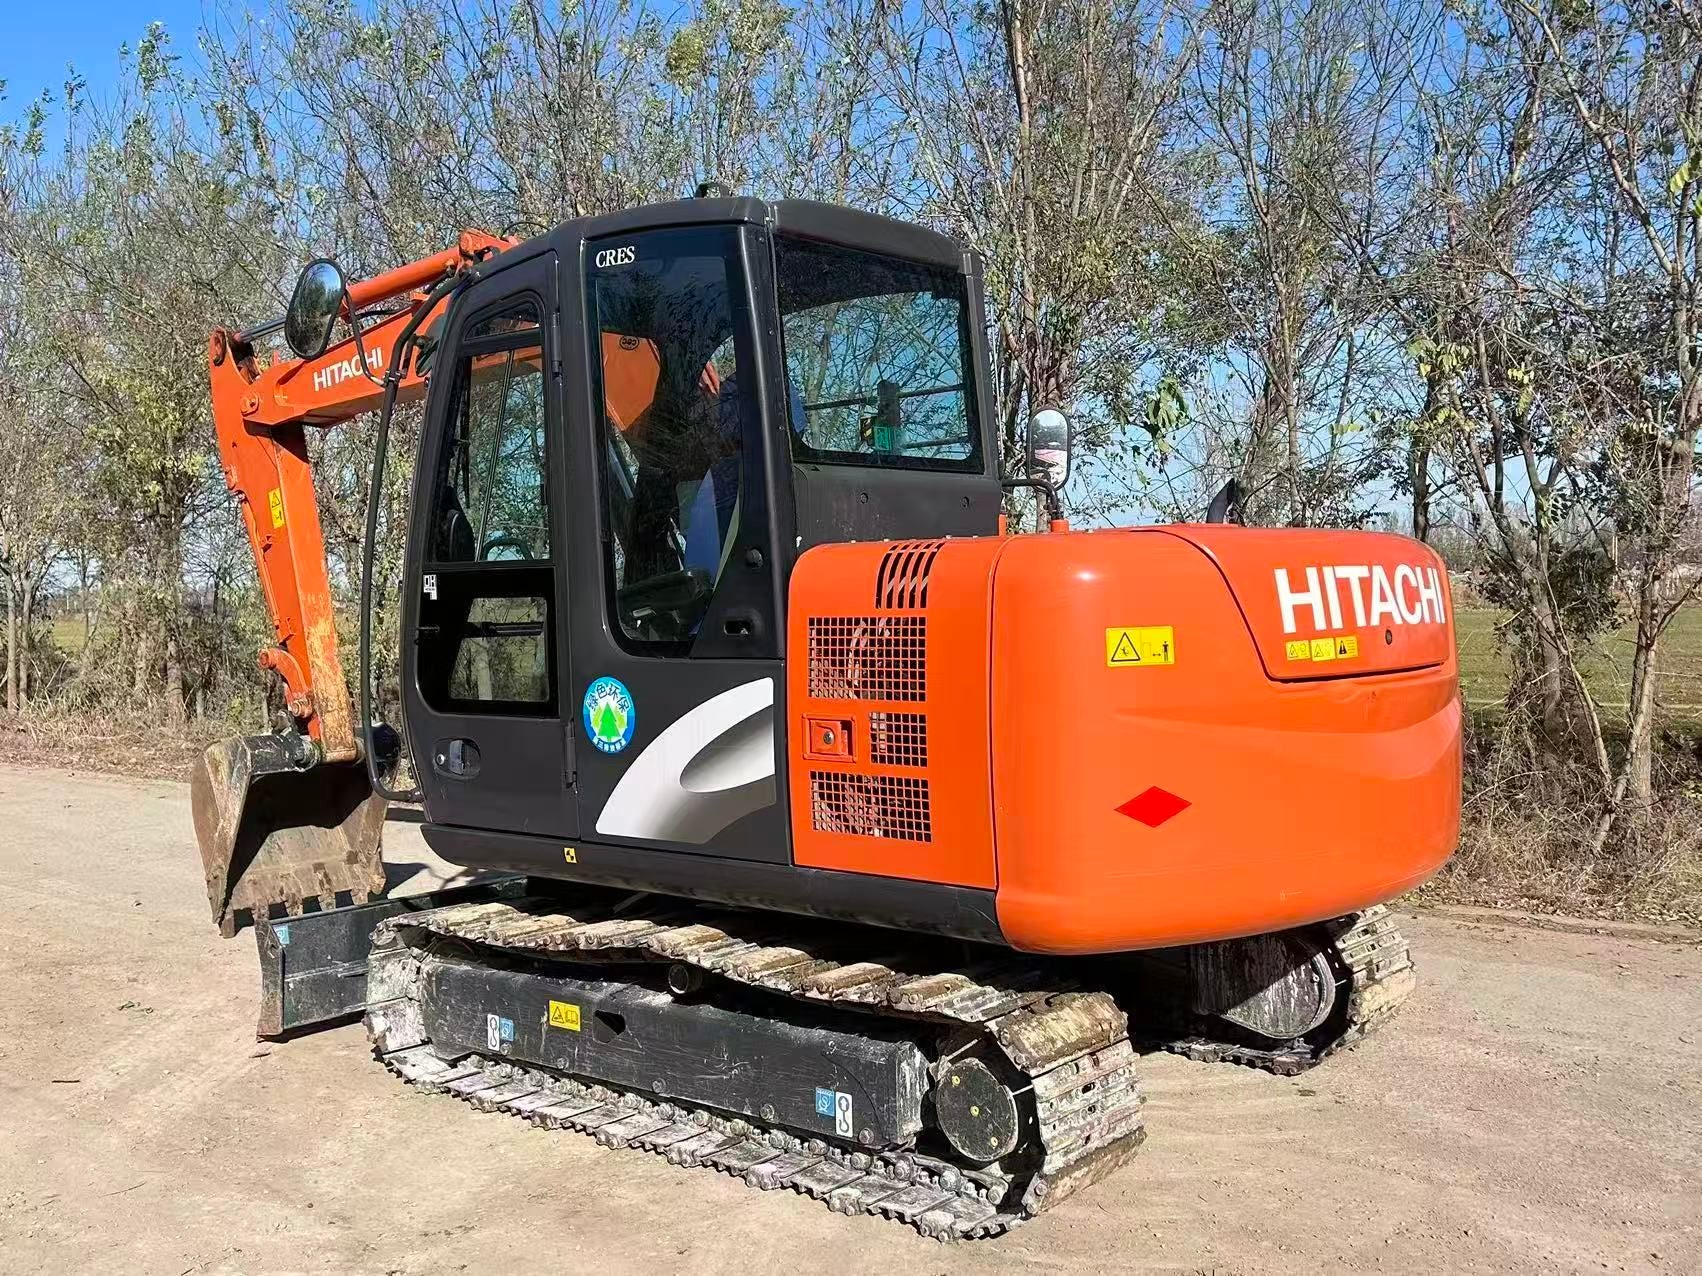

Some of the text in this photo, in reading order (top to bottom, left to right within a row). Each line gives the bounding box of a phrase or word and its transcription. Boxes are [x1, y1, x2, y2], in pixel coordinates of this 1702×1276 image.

[595, 245, 635, 268] CRES
[313, 347, 383, 392] HITACHI
[1274, 563, 1446, 634] HITACHI
[586, 683, 630, 713] 绿色环保
